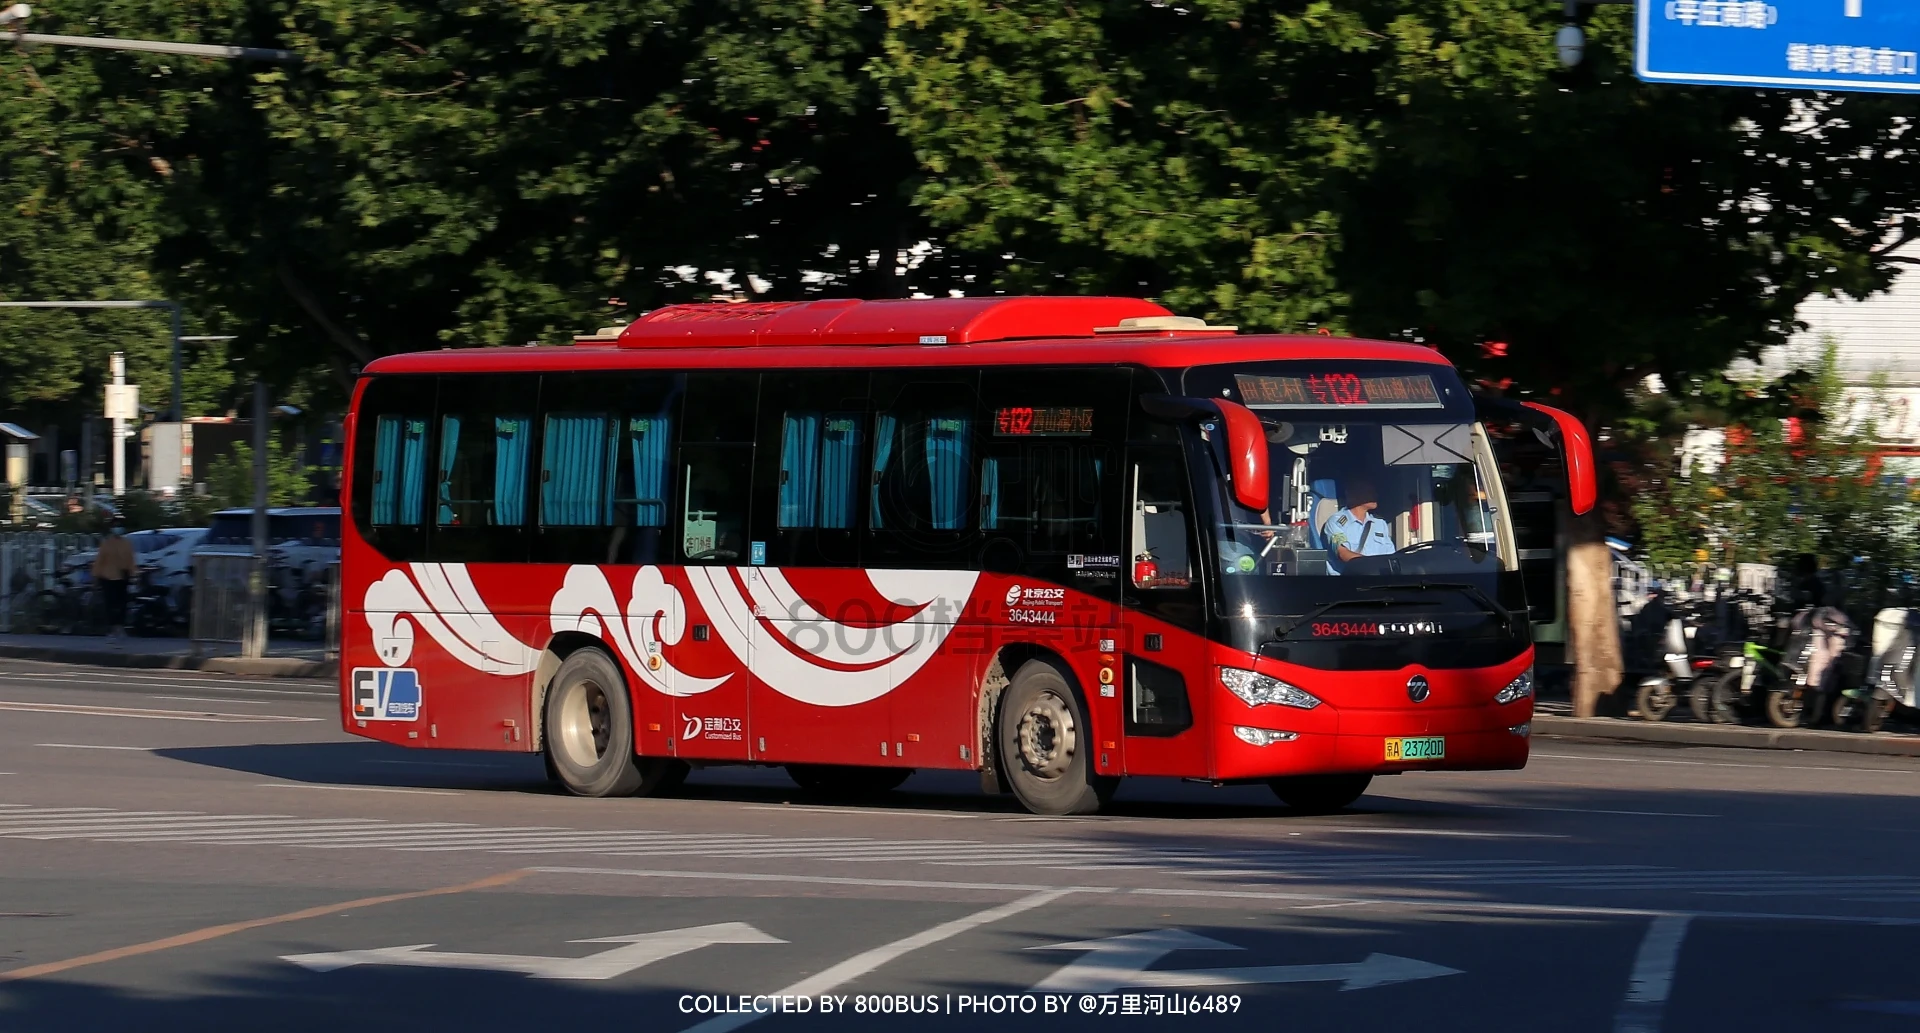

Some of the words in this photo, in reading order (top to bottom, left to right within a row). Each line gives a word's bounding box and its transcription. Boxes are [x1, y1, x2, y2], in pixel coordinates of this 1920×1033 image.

[1022, 588, 1065, 599] 北京公交
[1009, 608, 1055, 624] 3643444
[1311, 622, 1377, 636] 3643444
[704, 717, 742, 731] 定制公交
[704, 731, 732, 740] Customized
[732, 732, 742, 741] Bus
